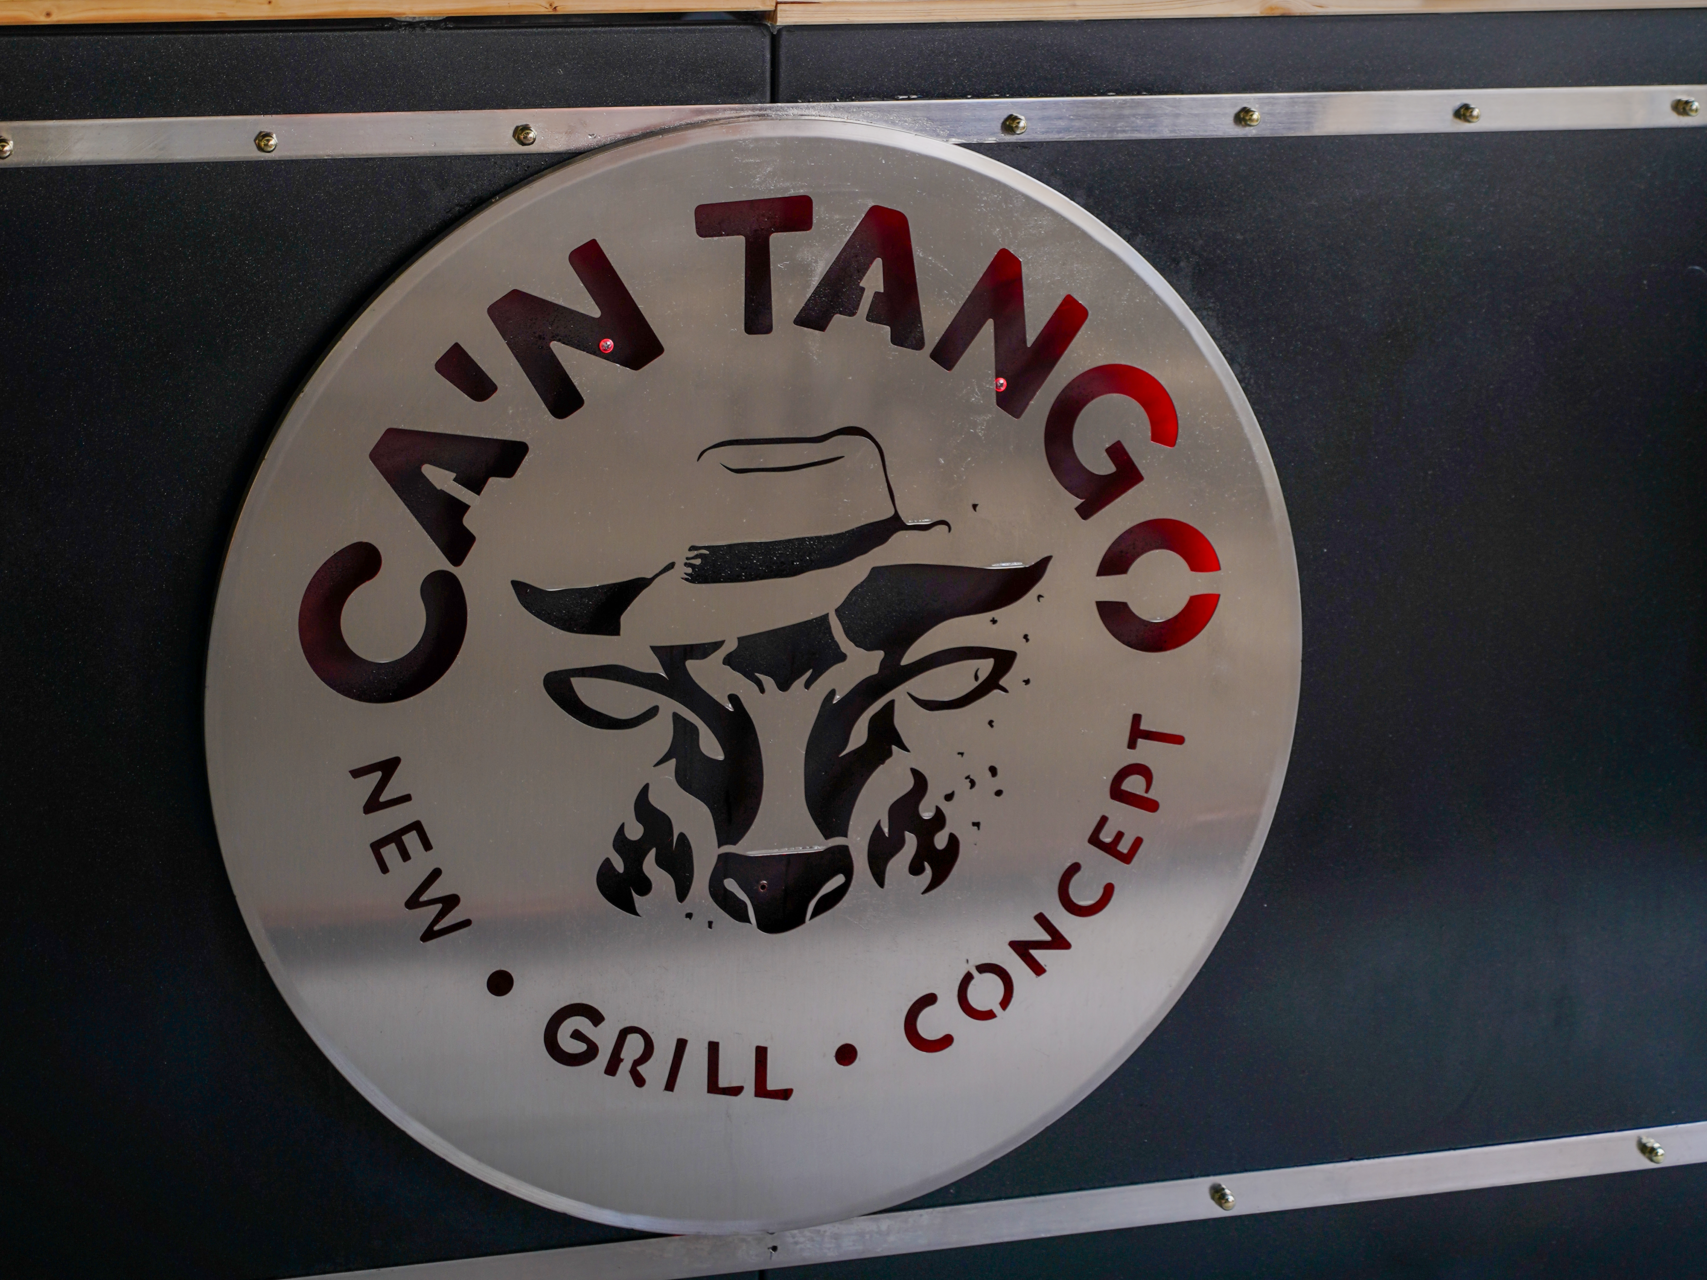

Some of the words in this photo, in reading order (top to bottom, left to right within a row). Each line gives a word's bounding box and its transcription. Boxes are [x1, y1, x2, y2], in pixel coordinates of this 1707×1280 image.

[298, 238, 665, 704] CA'N
[693, 194, 1222, 653] TANGO
[348, 755, 473, 944] NEW
[543, 1002, 794, 1101] GRILL
[903, 713, 1186, 1053] CONCEPT
